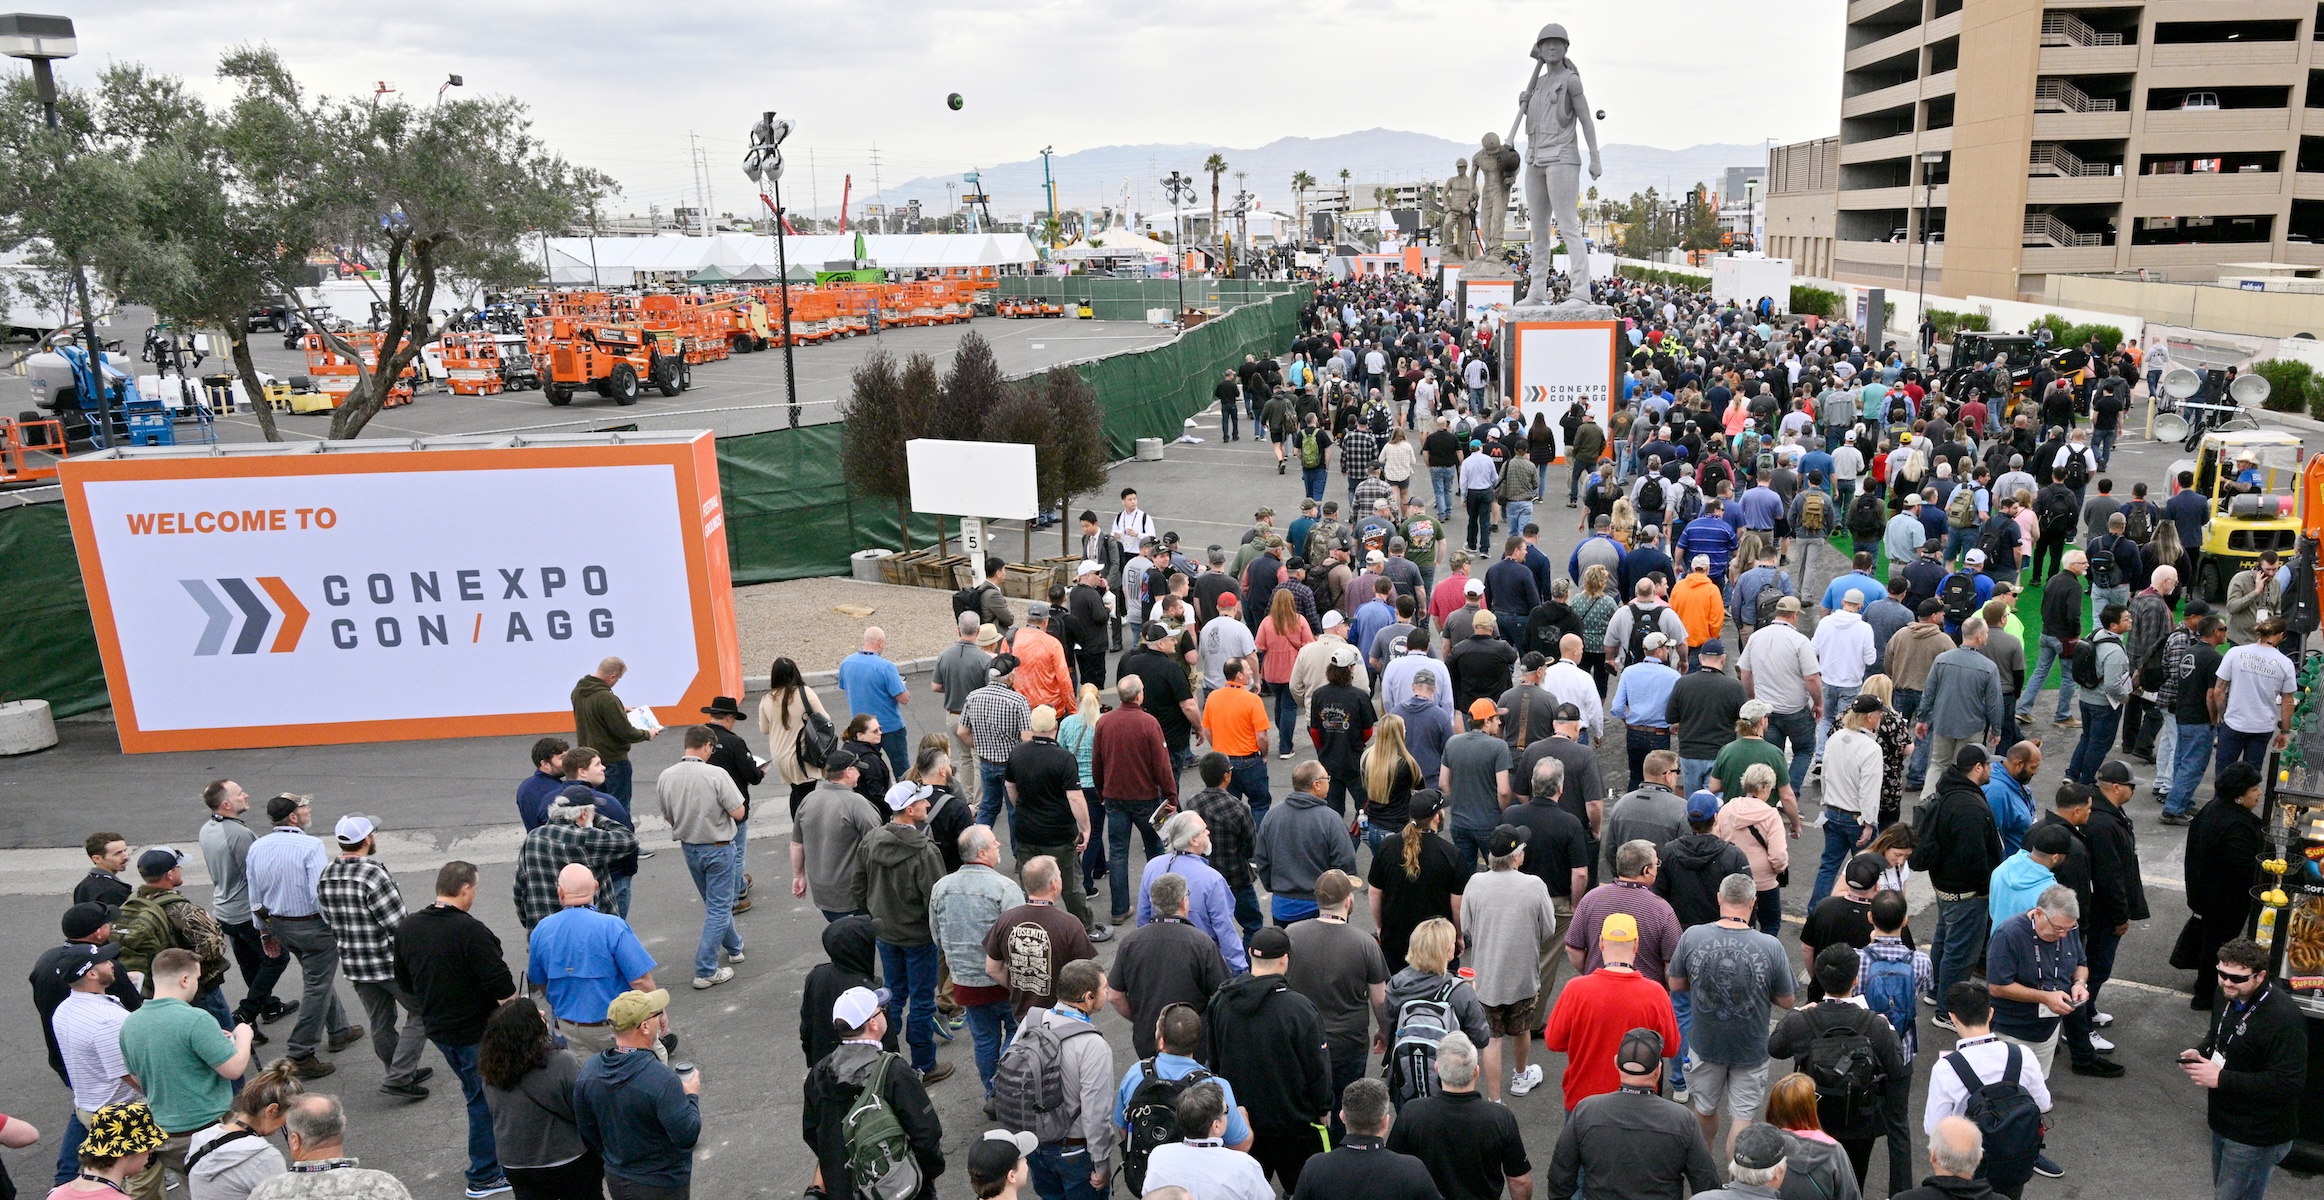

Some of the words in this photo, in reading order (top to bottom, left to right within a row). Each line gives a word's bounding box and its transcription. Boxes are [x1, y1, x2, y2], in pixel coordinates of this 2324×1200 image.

[1550, 385, 1607, 393] CONEXPO
[126, 509, 287, 536] WELCOME
[294, 507, 337, 530] TO
[969, 536, 978, 549] 5
[322, 565, 609, 607] CONEXPO
[1012, 926, 1048, 942] YOSEMITE
[1712, 937, 1738, 949] AIR
